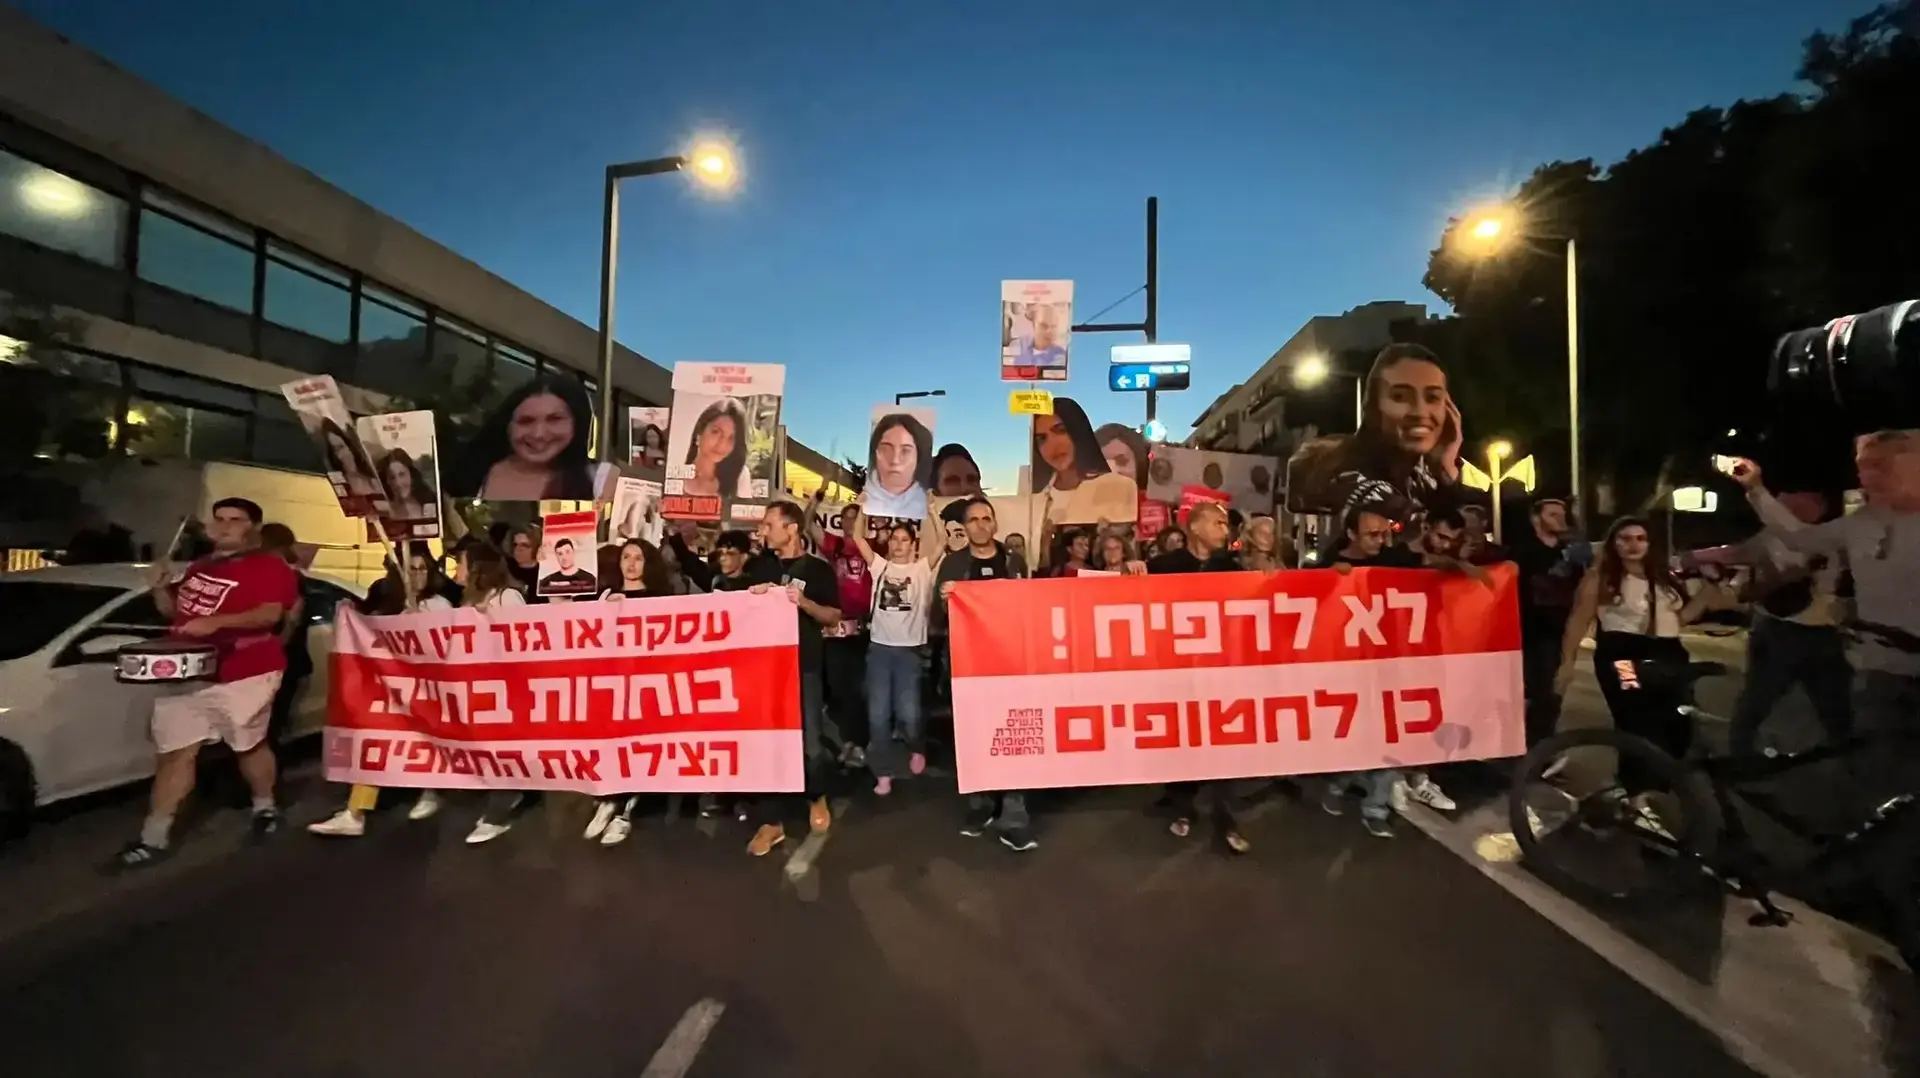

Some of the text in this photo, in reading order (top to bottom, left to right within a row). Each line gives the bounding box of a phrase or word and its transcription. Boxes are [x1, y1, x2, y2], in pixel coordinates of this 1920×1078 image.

[489, 621, 552, 652] גזר
[564, 617, 603, 649] או
[616, 610, 731, 651] עסקה
[1093, 592, 1318, 659] לרפיח
[1344, 588, 1428, 646] לא
[428, 625, 477, 660] דין
[527, 667, 739, 723] בוחרות
[1006, 718, 1043, 727] הנשים
[1054, 687, 1443, 753] כן לחטופים
[359, 739, 531, 779] החטופים
[537, 749, 602, 781] את
[617, 740, 738, 779] הצילו
